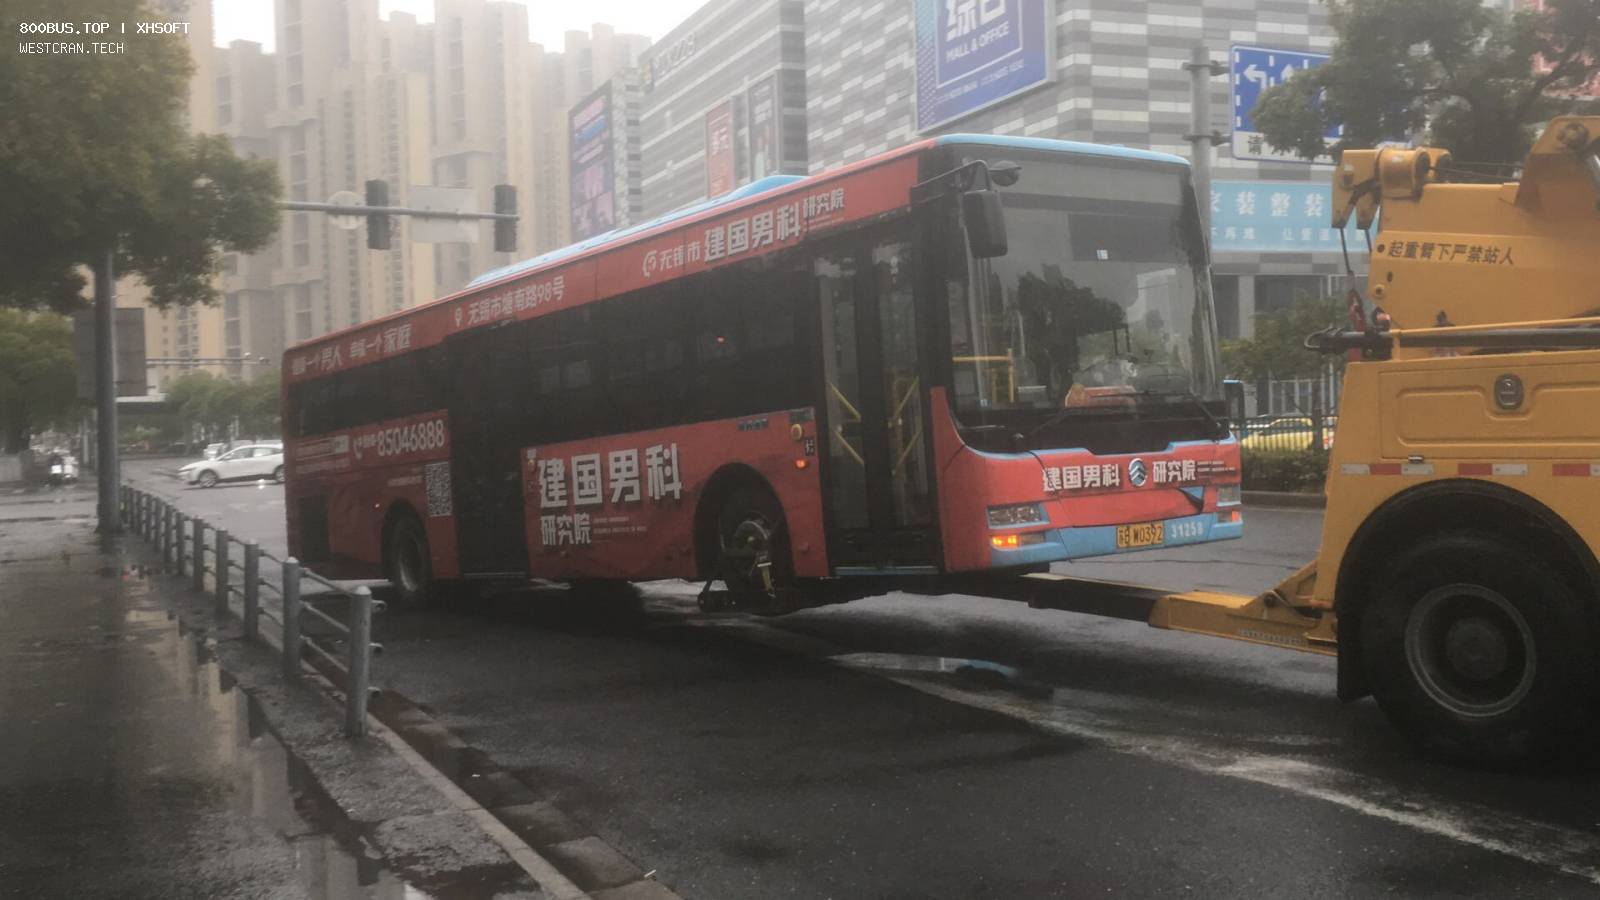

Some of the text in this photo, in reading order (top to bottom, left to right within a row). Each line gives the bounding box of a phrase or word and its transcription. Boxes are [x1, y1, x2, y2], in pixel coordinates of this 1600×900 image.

[945, 21, 1010, 63] MALL & OFFICE
[1388, 240, 1514, 265] 起重臂下严禁站人
[376, 419, 445, 457] 85046888
[537, 442, 682, 508] 建国男科
[1043, 463, 1120, 492] 建国男科
[1152, 460, 1197, 483] 研究院
[540, 512, 592, 546] 研究院
